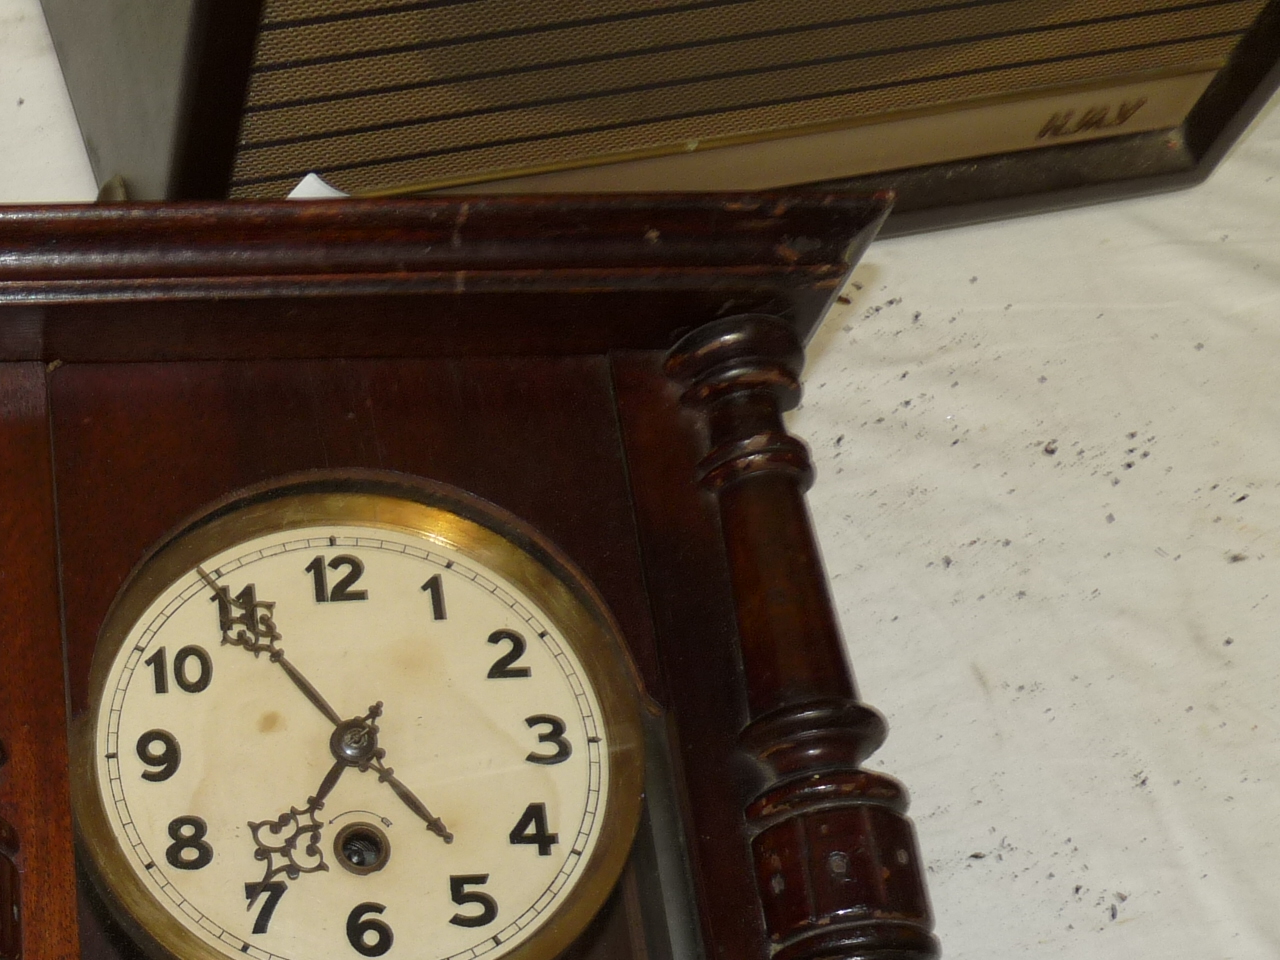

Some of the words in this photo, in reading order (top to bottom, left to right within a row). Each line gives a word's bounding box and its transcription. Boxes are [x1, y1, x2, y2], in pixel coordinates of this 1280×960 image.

[1037, 97, 1148, 140] HMV
[305, 554, 369, 603] 12
[421, 573, 448, 621] 1
[144, 644, 214, 694] 10
[487, 628, 532, 679] 2
[135, 728, 182, 783] 9
[523, 713, 573, 766] 3
[165, 814, 214, 870] 8
[508, 801, 559, 857] 4
[244, 880, 289, 935] 7
[449, 872, 500, 928] 5
[346, 901, 395, 958] 6
